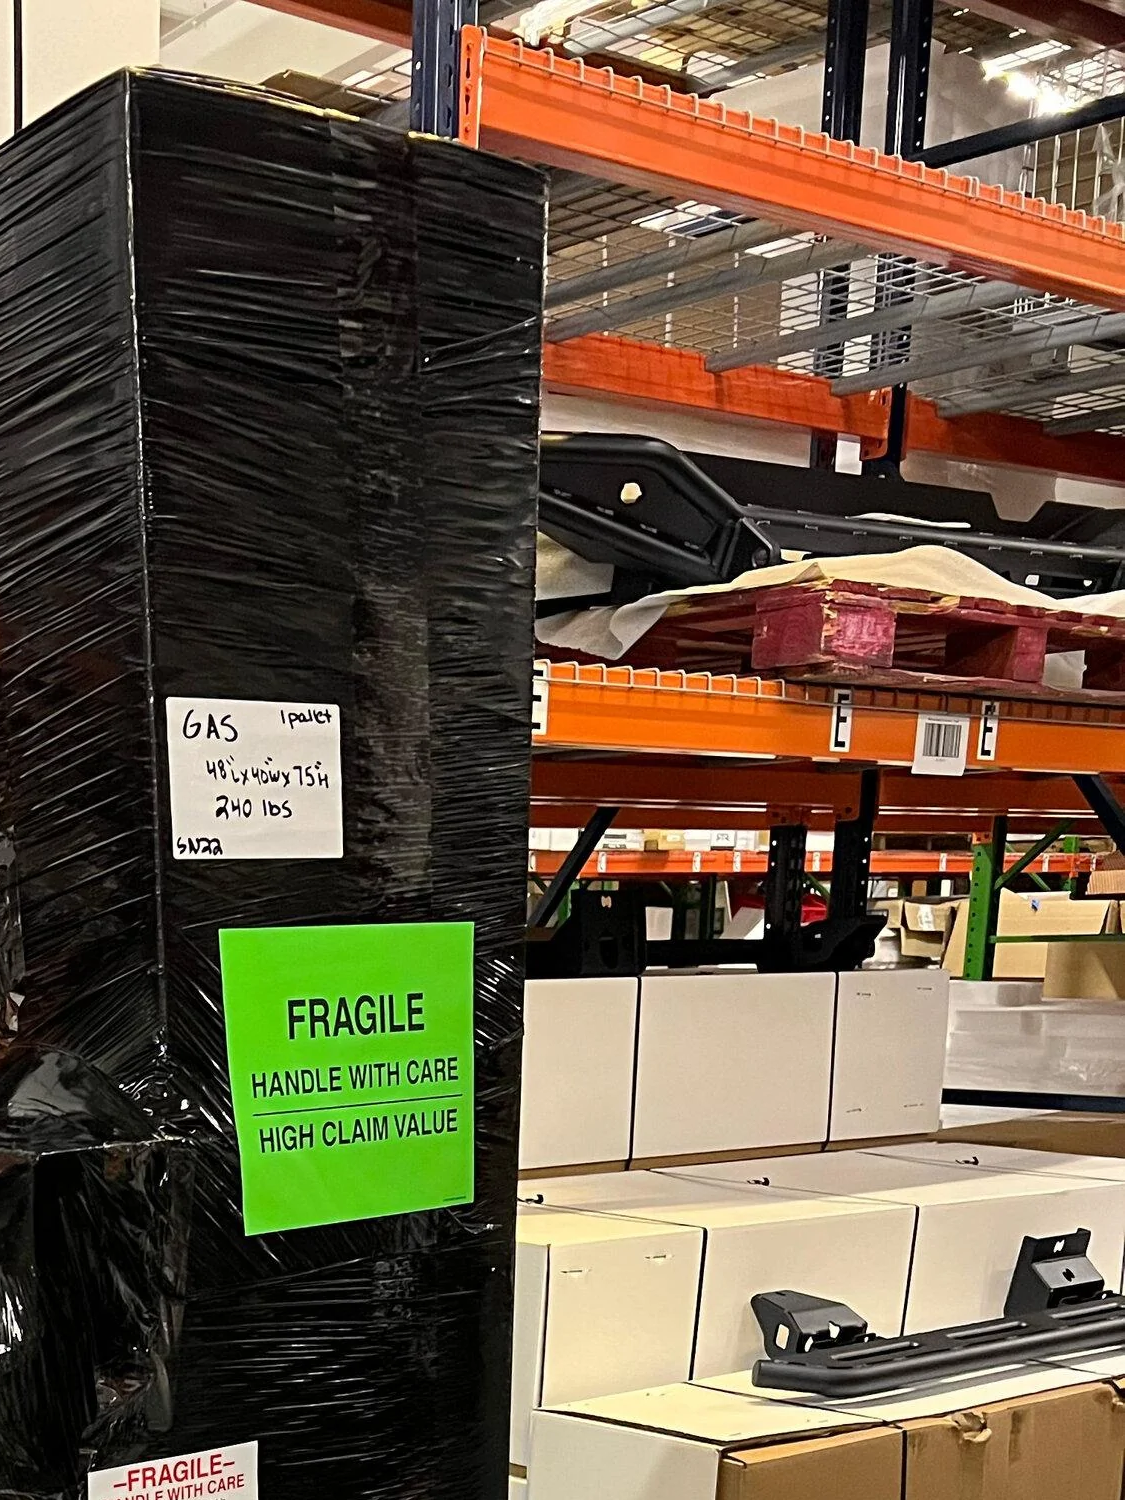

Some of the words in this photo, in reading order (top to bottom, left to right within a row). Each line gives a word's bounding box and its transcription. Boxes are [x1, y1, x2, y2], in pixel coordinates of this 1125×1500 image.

[182, 709, 239, 742] GAS
[834, 693, 850, 748] E
[980, 704, 996, 756] E
[215, 795, 252, 820] 240
[263, 799, 293, 818] lbs
[287, 992, 426, 1040] FRAGILE
[251, 1066, 342, 1098] HANDLE
[348, 1062, 400, 1090] WITH
[406, 1056, 459, 1085] CARE
[259, 1123, 314, 1153] HIGH
[322, 1116, 388, 1147] CLAIM
[394, 1108, 458, 1139] VALUE
[207, 1474, 245, 1494] CARE
